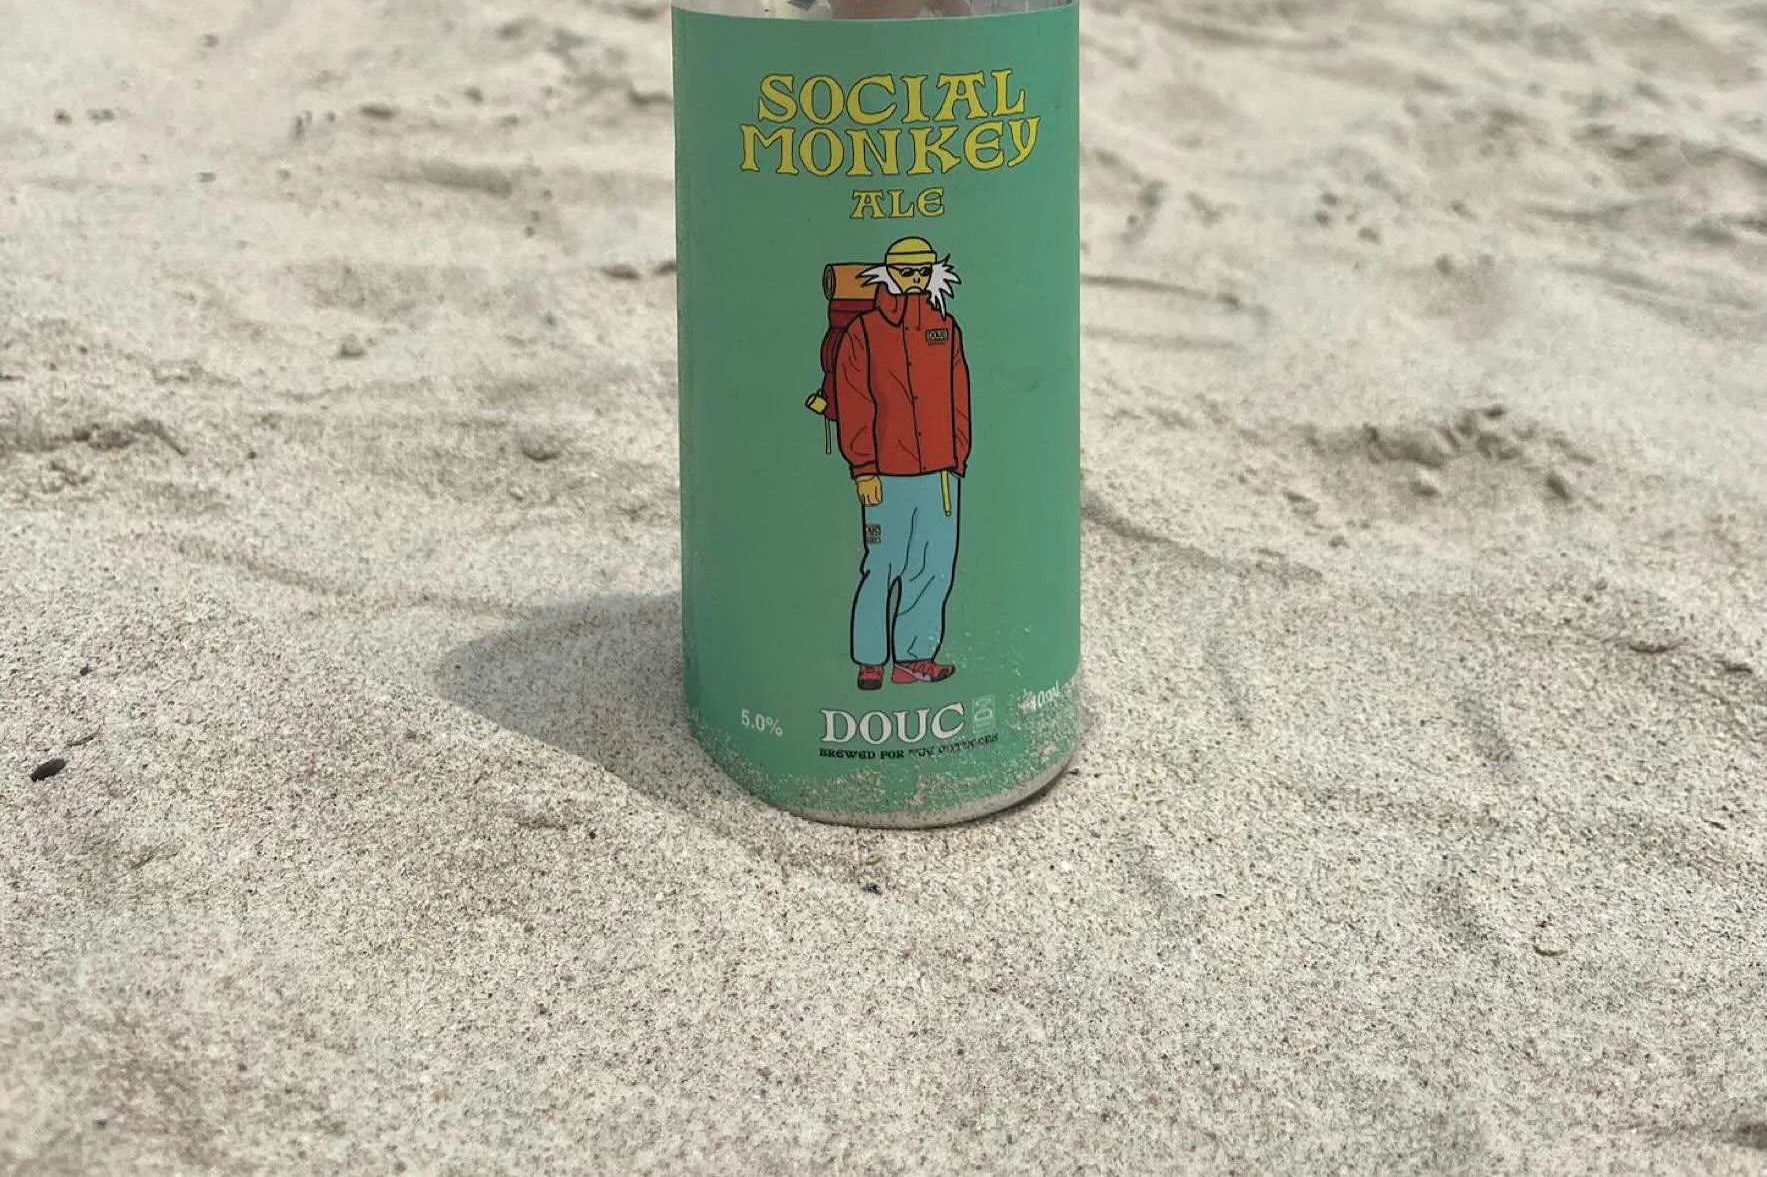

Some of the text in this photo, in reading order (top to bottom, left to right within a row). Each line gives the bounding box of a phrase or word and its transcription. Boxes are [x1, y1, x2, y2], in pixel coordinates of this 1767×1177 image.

[757, 68, 1026, 125] SOCIAL
[739, 115, 1041, 177] MONKEY
[850, 186, 946, 220] ALE
[741, 707, 784, 737] 5.0%
[819, 702, 965, 745] DOUC
[819, 748, 876, 760] BREWED
[880, 749, 905, 760] FOR
